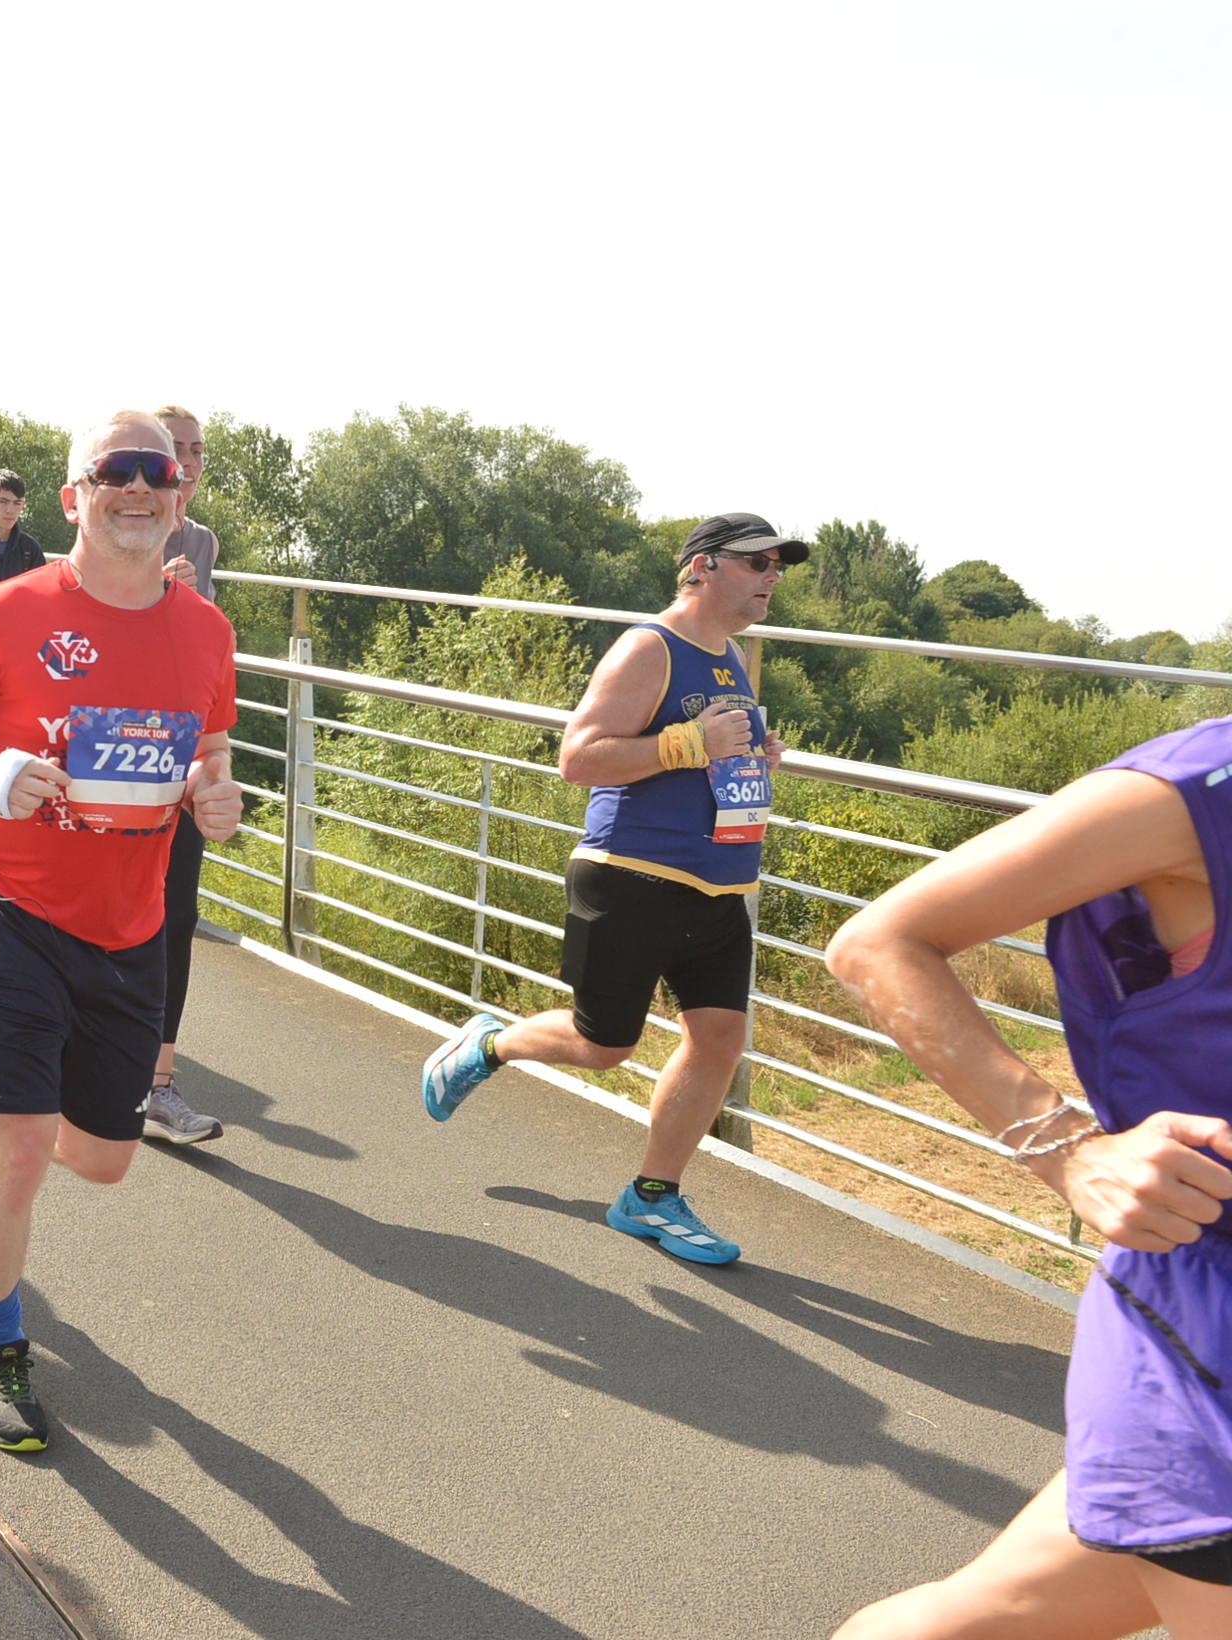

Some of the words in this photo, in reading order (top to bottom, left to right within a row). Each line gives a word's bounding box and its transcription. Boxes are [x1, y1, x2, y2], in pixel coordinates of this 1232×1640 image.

[711, 667, 737, 687] DC
[122, 727, 150, 738] YORK
[151, 728, 171, 740] 10K
[92, 742, 176, 775] 7226
[726, 780, 765, 804] 3621
